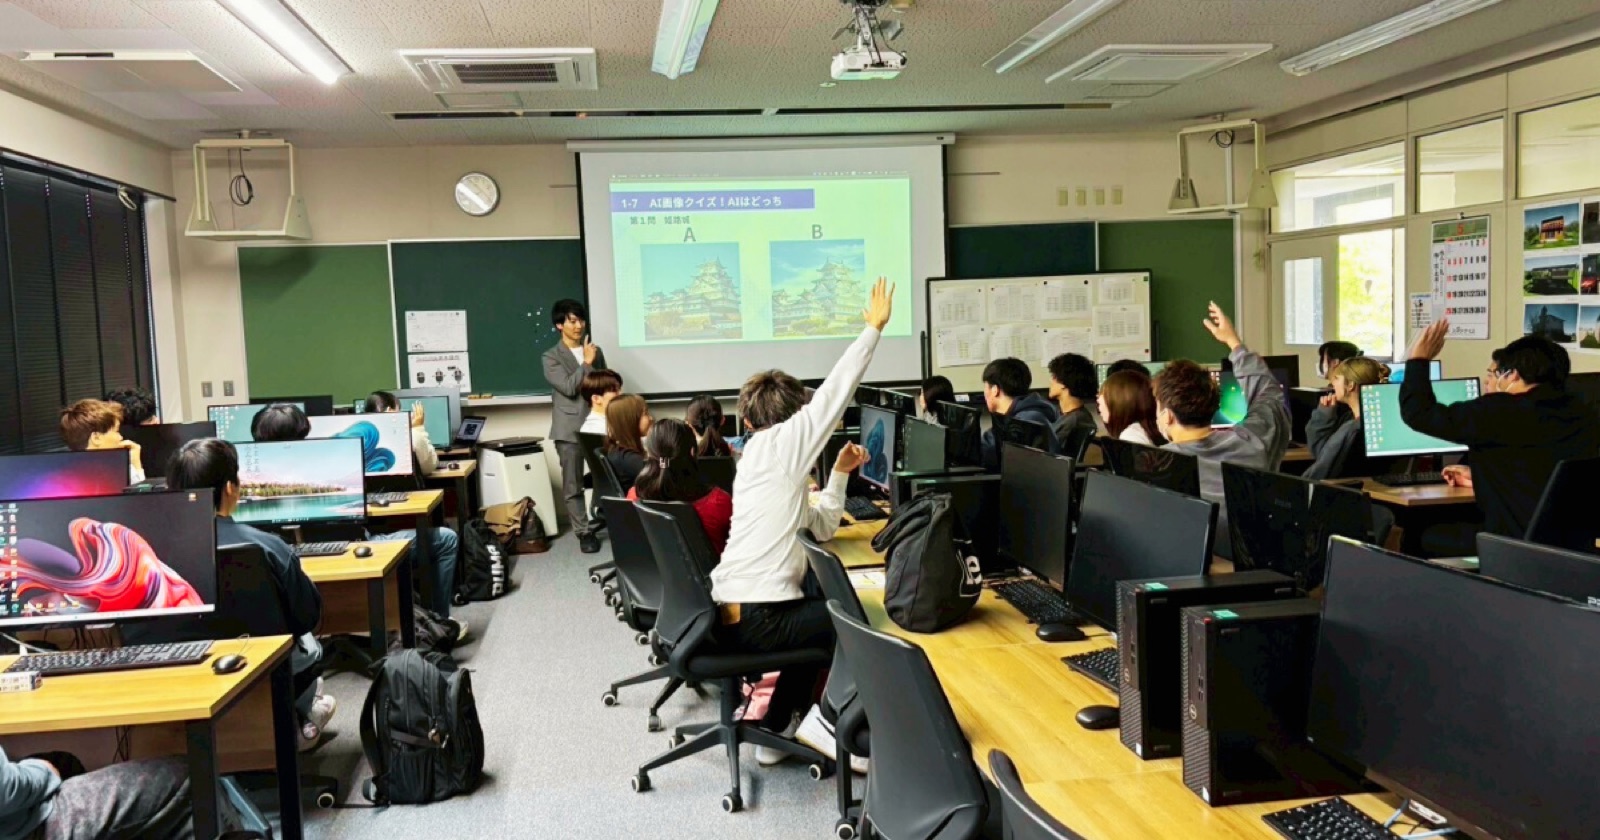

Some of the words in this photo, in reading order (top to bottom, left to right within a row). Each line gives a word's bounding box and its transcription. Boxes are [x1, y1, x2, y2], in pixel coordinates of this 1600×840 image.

[621, 198, 638, 209] 1-7
[683, 227, 697, 242] A
[811, 224, 823, 239] B
